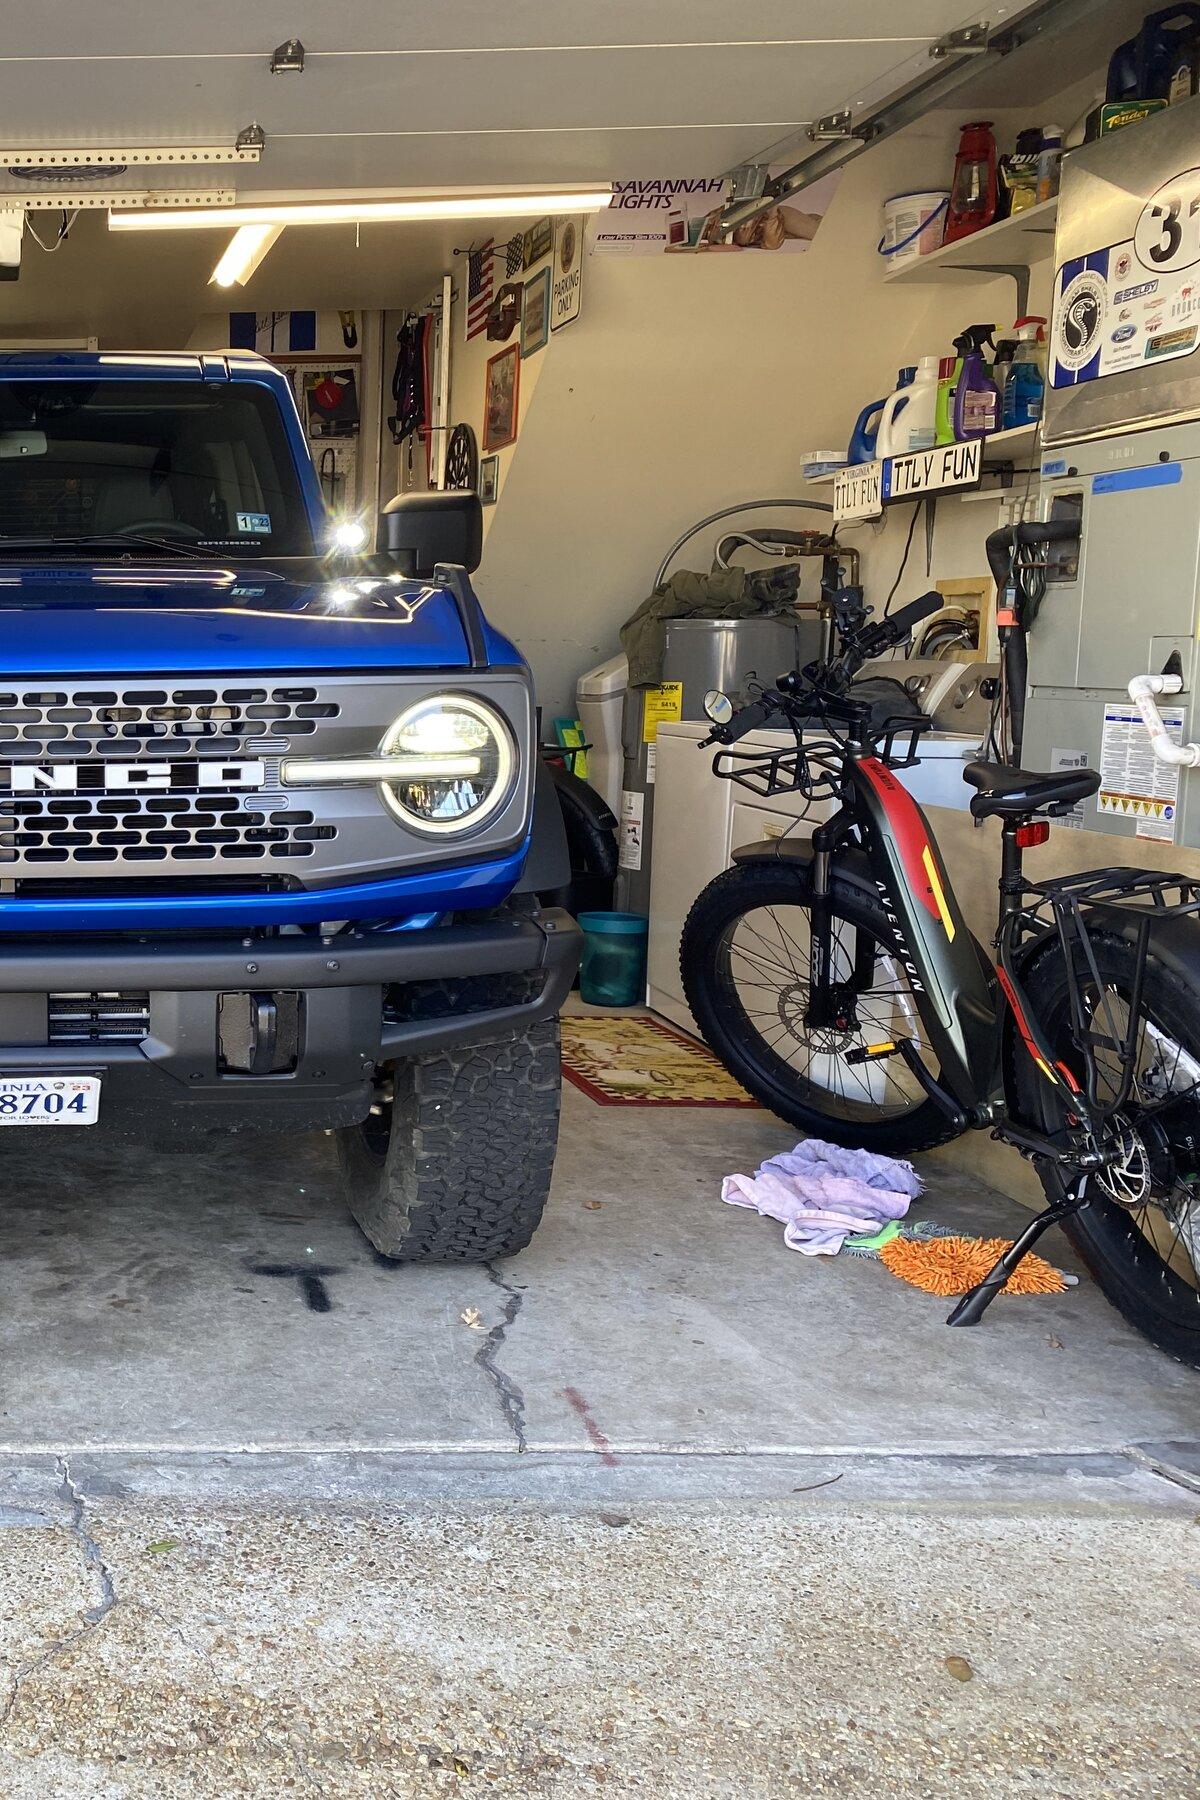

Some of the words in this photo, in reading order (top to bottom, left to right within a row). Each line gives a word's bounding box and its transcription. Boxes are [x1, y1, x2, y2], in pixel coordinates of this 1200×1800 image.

[612, 178, 724, 194] SAVANNAH
[608, 194, 674, 209] LIGHTS
[1149, 193, 1200, 263] 3
[554, 269, 579, 298] PARKING
[1123, 282, 1157, 300] SHELBY
[558, 291, 573, 315] ONLY
[894, 455, 933, 492] TTLY
[942, 445, 977, 483] FUN
[835, 482, 857, 511] TTLY
[861, 477, 879, 505] FUN
[241, 517, 248, 528] 1
[875, 880, 925, 993] AVENTON
